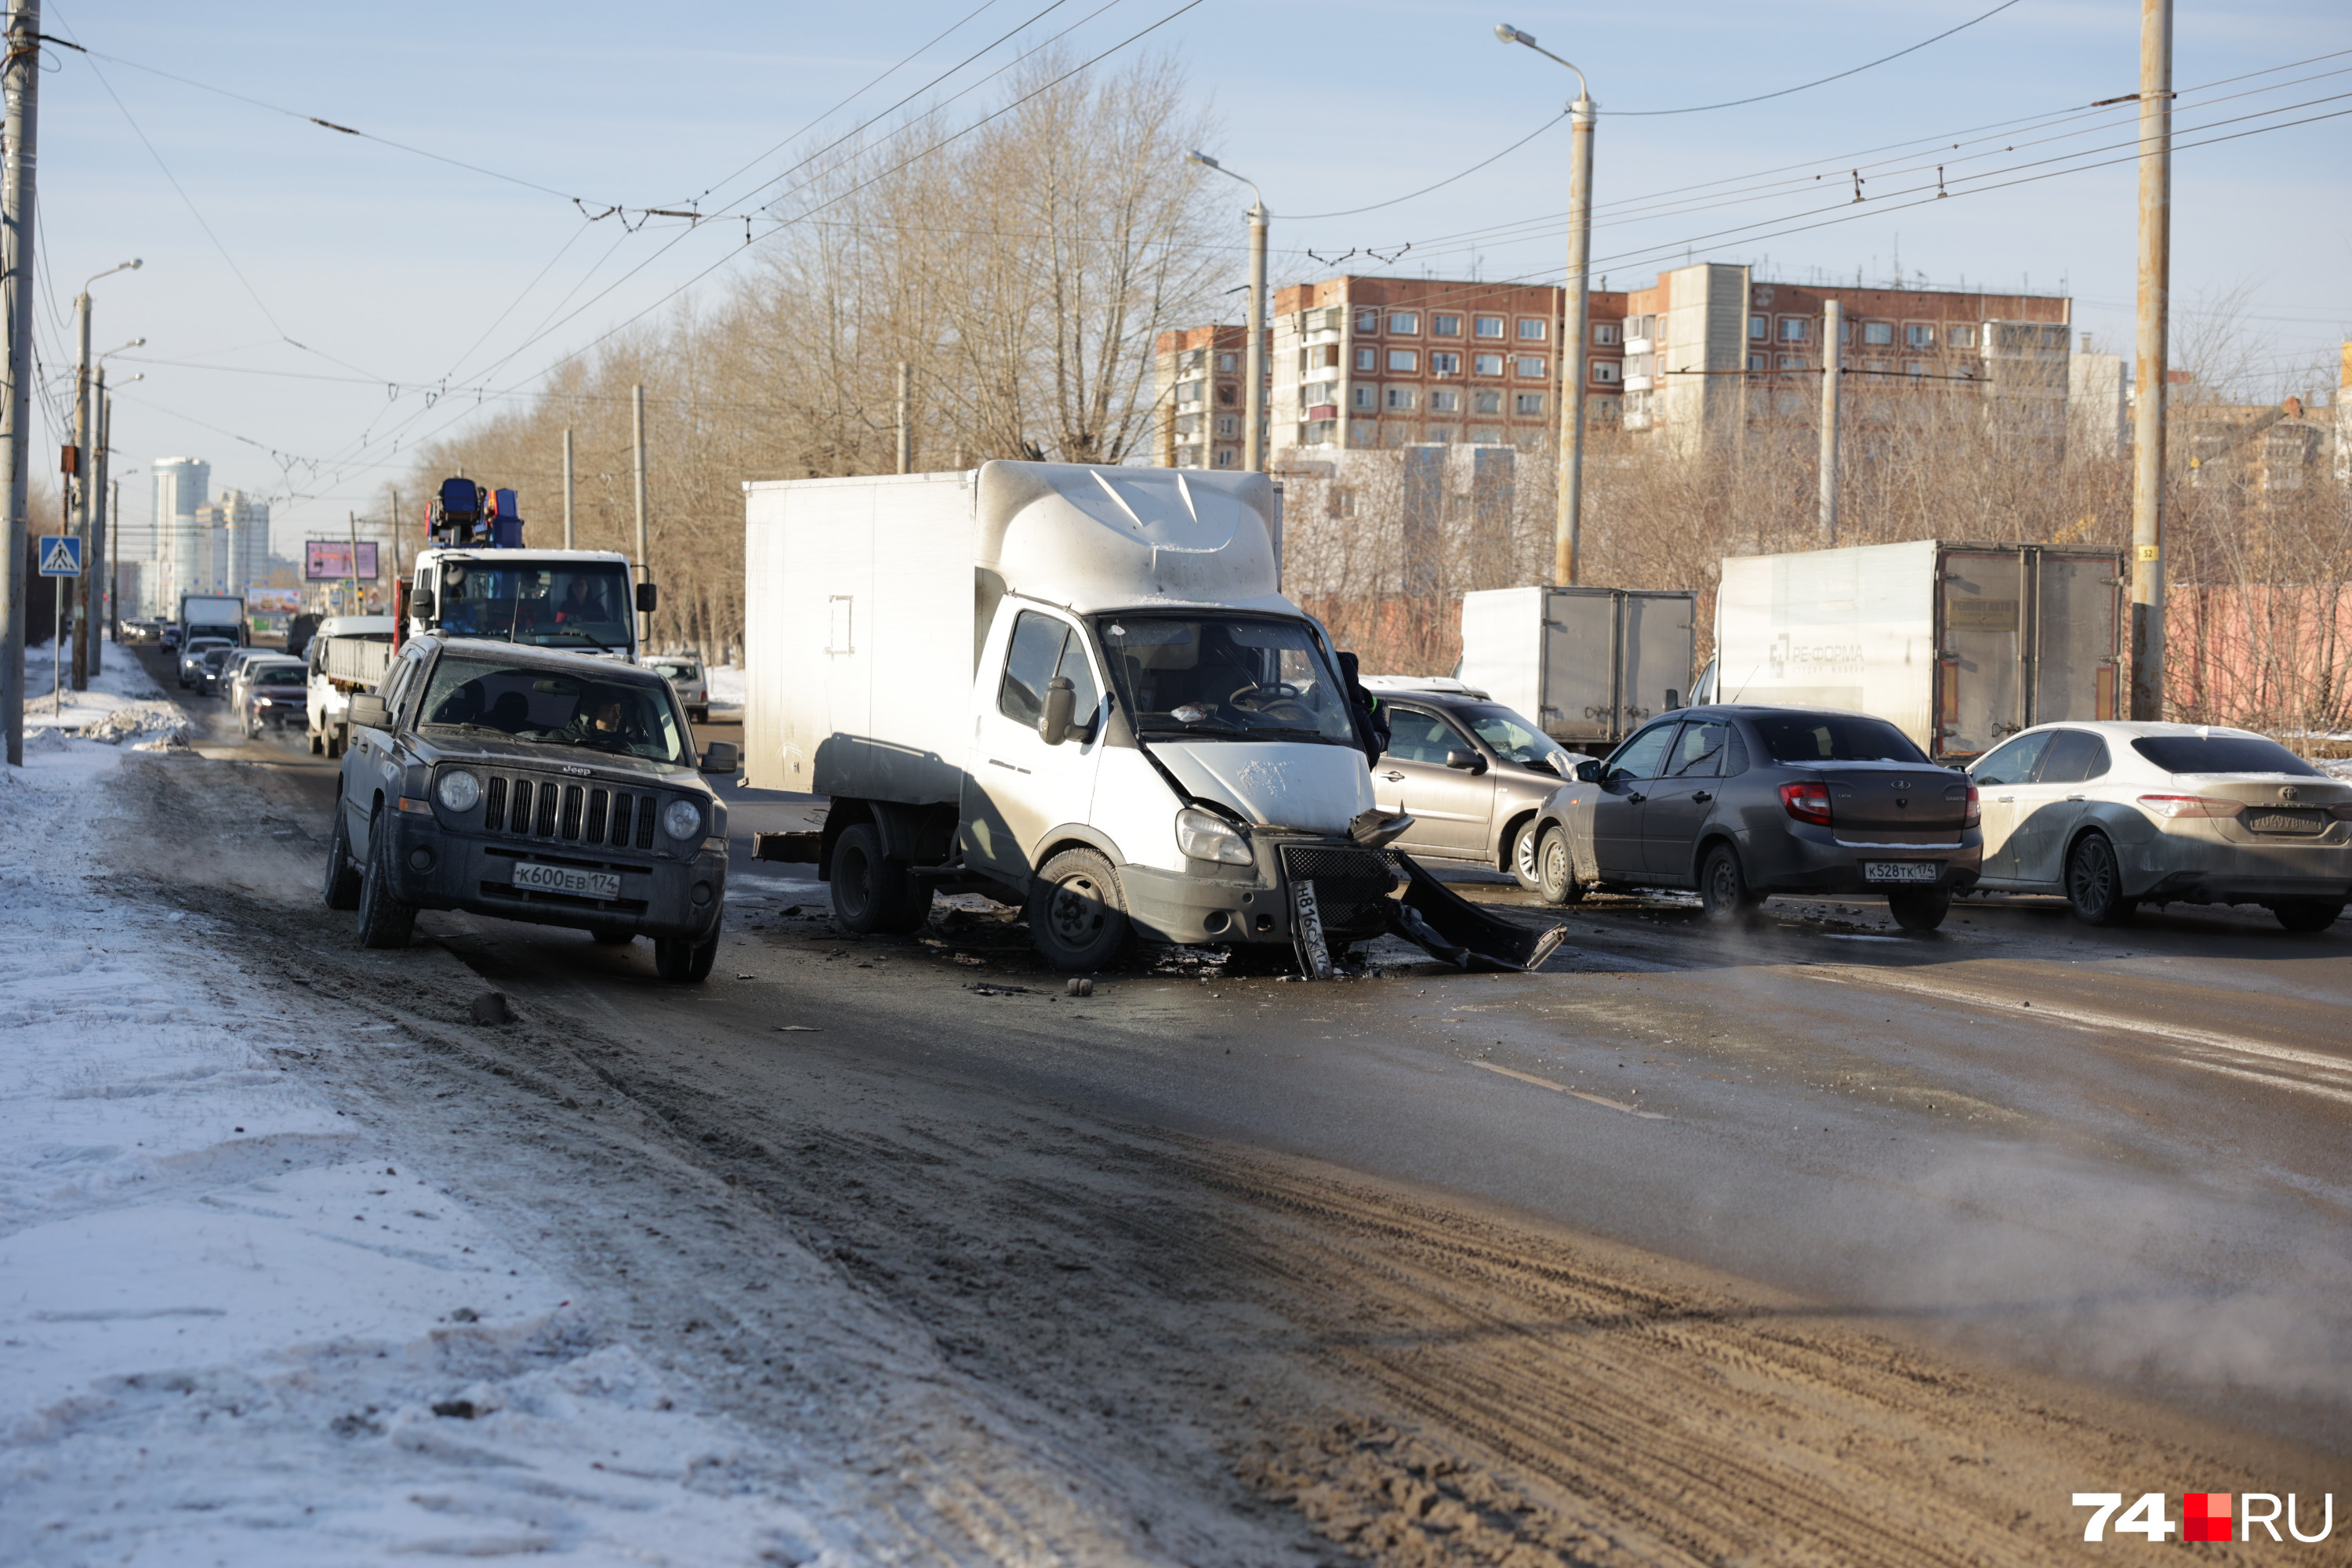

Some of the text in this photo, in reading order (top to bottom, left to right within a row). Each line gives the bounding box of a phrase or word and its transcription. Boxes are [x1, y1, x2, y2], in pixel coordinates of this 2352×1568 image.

[1792, 644, 1864, 662] РЕ-ФОРМА
[563, 765, 591, 776] Jeep
[520, 866, 614, 890] К600ЕВ 174
[1869, 864, 1934, 878] К528ТК 174
[1298, 887, 1320, 949] Н816СХ
